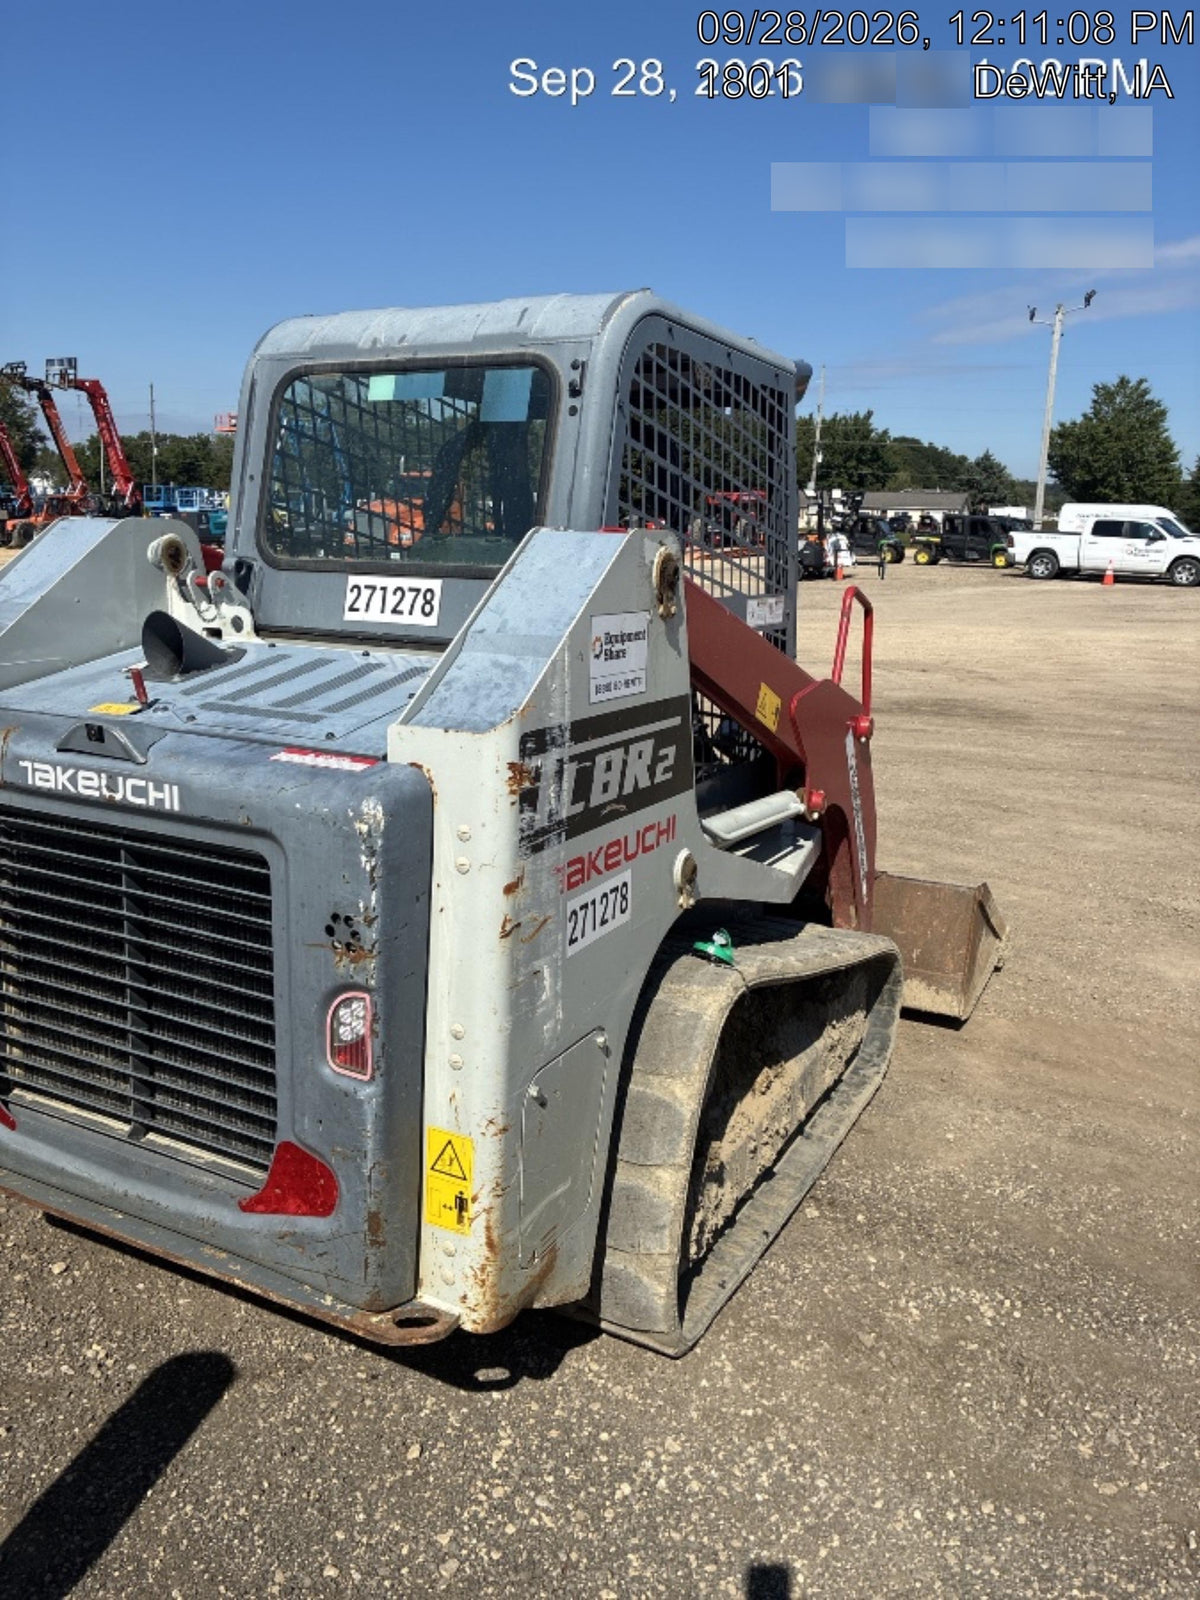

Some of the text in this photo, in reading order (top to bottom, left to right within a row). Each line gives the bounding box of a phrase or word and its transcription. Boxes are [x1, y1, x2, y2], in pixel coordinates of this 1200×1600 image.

[348, 584, 435, 617] 271278
[18, 759, 181, 812] TAKEUCHI
[567, 884, 630, 947] 271278
